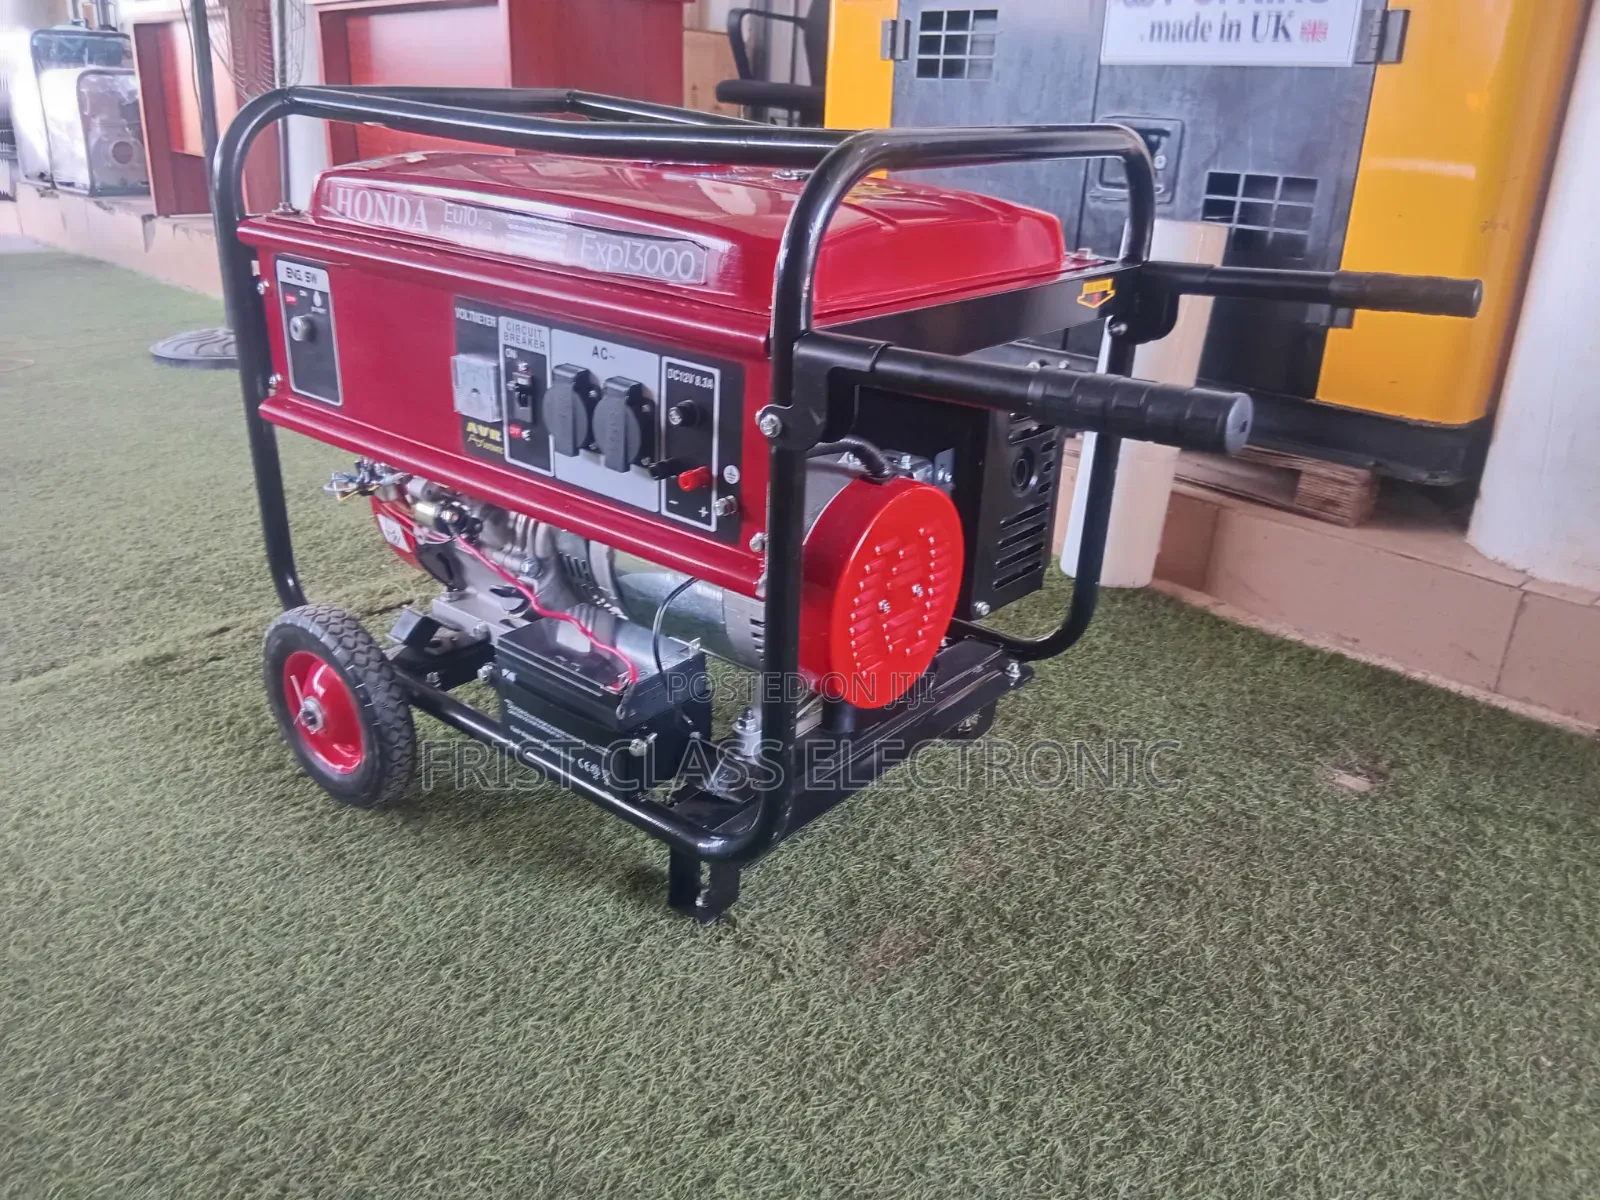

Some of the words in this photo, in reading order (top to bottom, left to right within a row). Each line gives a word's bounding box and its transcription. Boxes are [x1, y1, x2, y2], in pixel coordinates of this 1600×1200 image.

[1219, 10, 1241, 42] in
[1251, 10, 1295, 43] UK
[336, 187, 429, 230] HONDA
[455, 307, 498, 328] VOLTMETER
[503, 331, 546, 351] BREAKER
[505, 321, 542, 340] CIRCUIT
